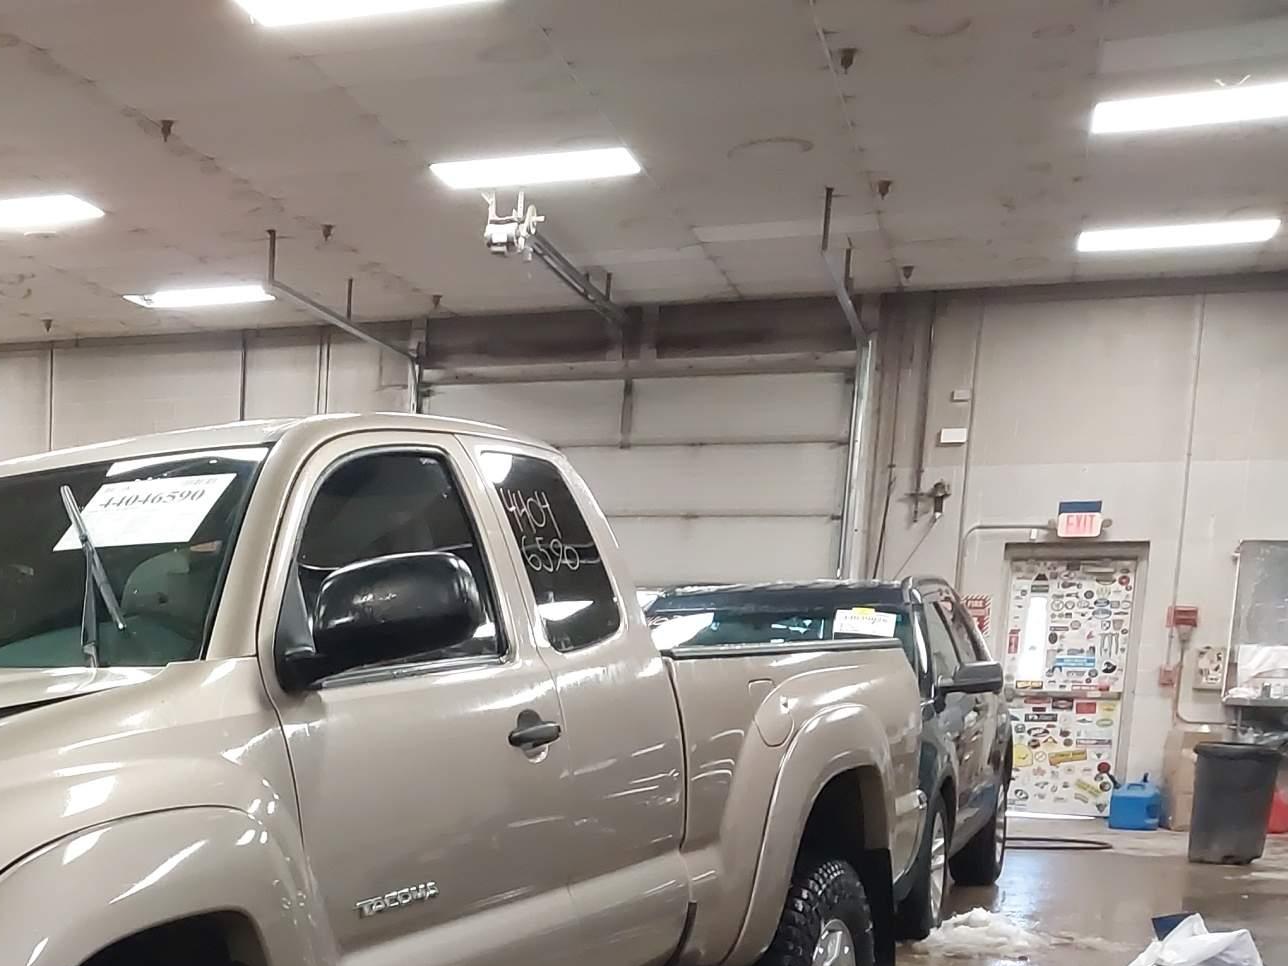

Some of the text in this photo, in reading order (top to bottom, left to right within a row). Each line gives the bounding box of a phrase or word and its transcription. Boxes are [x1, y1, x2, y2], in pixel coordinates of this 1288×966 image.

[500, 487, 562, 538] 4404
[1066, 514, 1097, 536] EXIT
[520, 535, 580, 572] 6590
[355, 881, 440, 917] TACOMA
